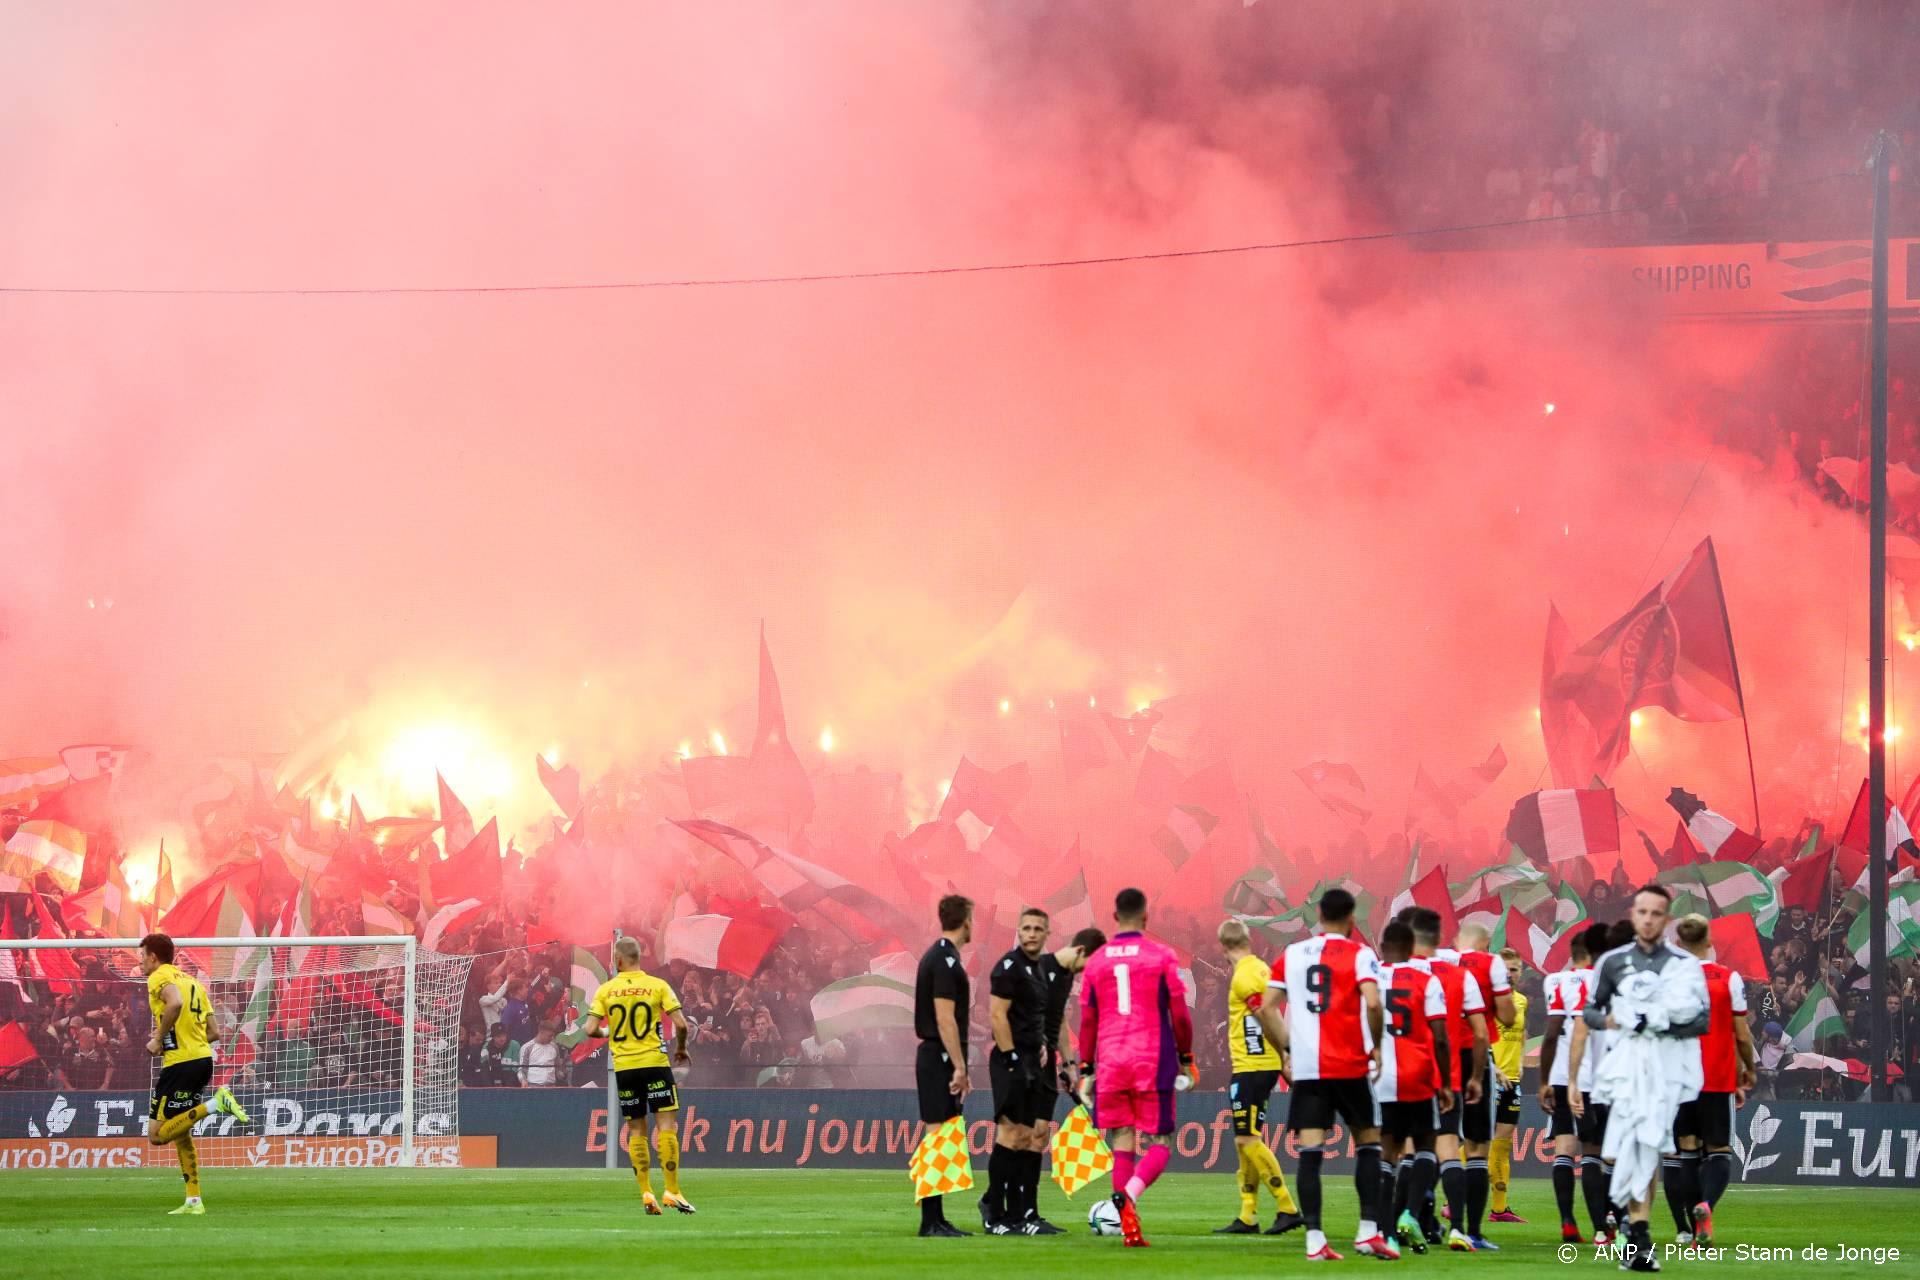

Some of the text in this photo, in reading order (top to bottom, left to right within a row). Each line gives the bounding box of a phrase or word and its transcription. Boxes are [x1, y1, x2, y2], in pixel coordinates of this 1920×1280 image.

[1632, 263, 1752, 292] SHIPPING
[190, 984, 202, 1021] 4
[1114, 963, 1131, 1015] 1
[1306, 964, 1331, 1013] 9
[609, 1001, 652, 1042] 20
[1386, 989, 1411, 1036] 5
[726, 1119, 788, 1155] nu
[796, 1103, 925, 1166] jouw
[1176, 1109, 1234, 1168] of
